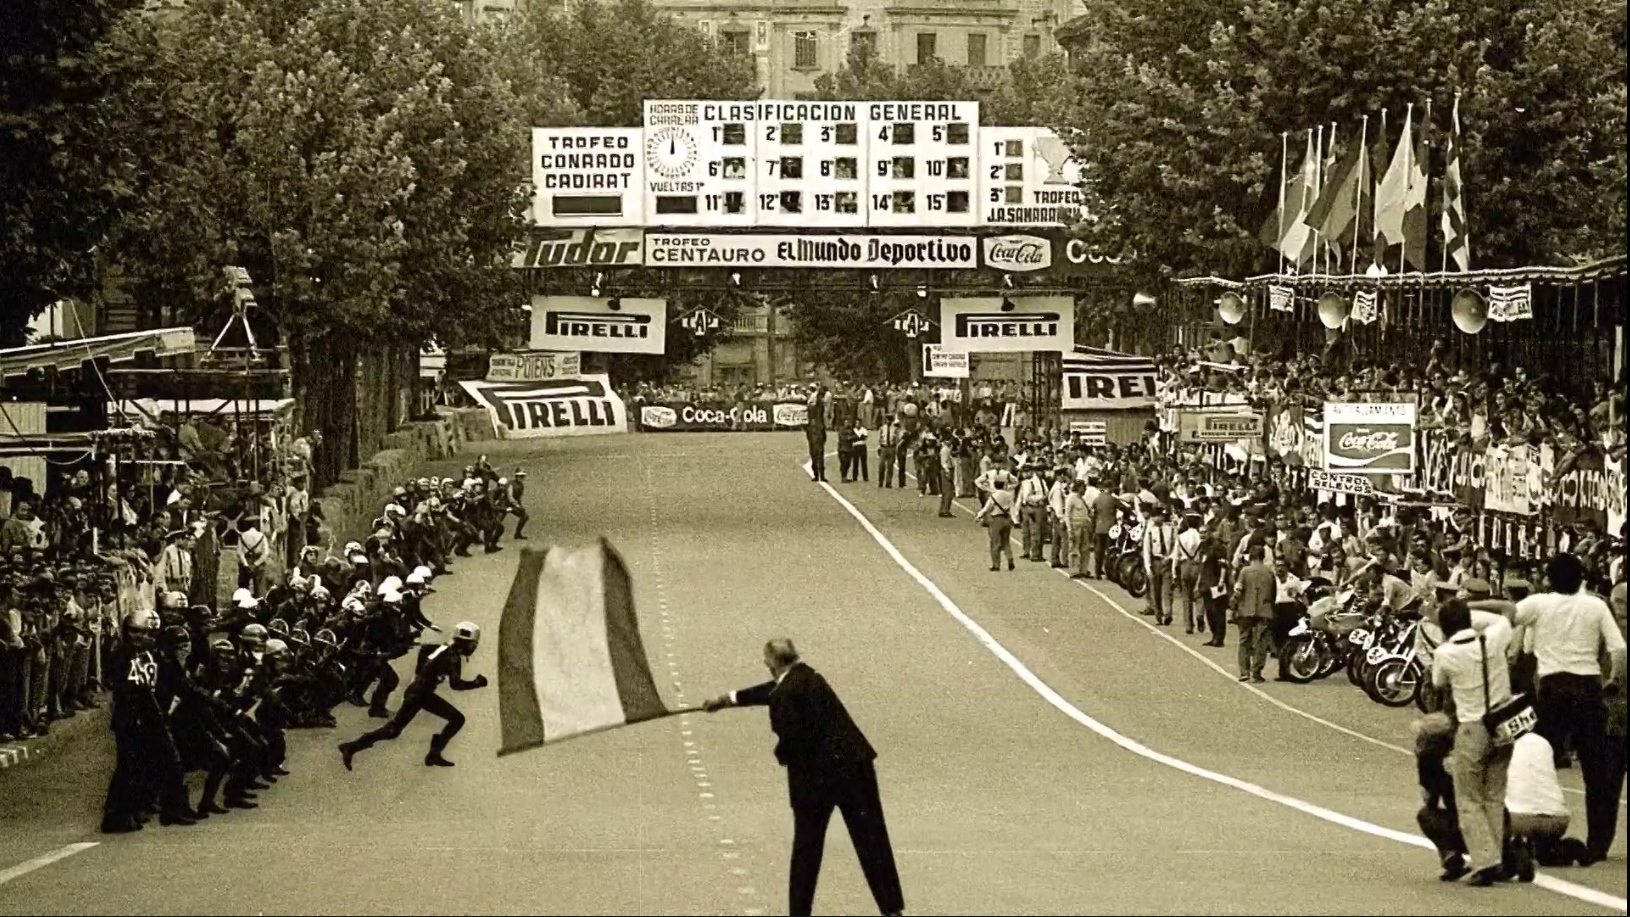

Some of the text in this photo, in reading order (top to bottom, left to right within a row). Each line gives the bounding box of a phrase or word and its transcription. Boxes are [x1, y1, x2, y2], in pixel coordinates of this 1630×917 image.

[650, 104, 698, 114] HORAS DE
[705, 105, 960, 120] CLASIFICACION GENERAL
[549, 137, 628, 149] TROFEO
[542, 154, 634, 169] CONRADO
[650, 181, 693, 192] VUELTAS
[1033, 191, 1080, 203] TROFEO
[987, 208, 1081, 222] J.A.SAMARA
[653, 238, 710, 246] TROFEO
[652, 248, 765, 262] CENTAURO
[798, 238, 861, 261] Mundo
[867, 238, 971, 265] Deportivo
[546, 311, 652, 338] PIRELLI
[956, 312, 1060, 338] PIRELLI
[477, 380, 616, 430] PIRELLI
[1311, 472, 1369, 485] CONTROL
